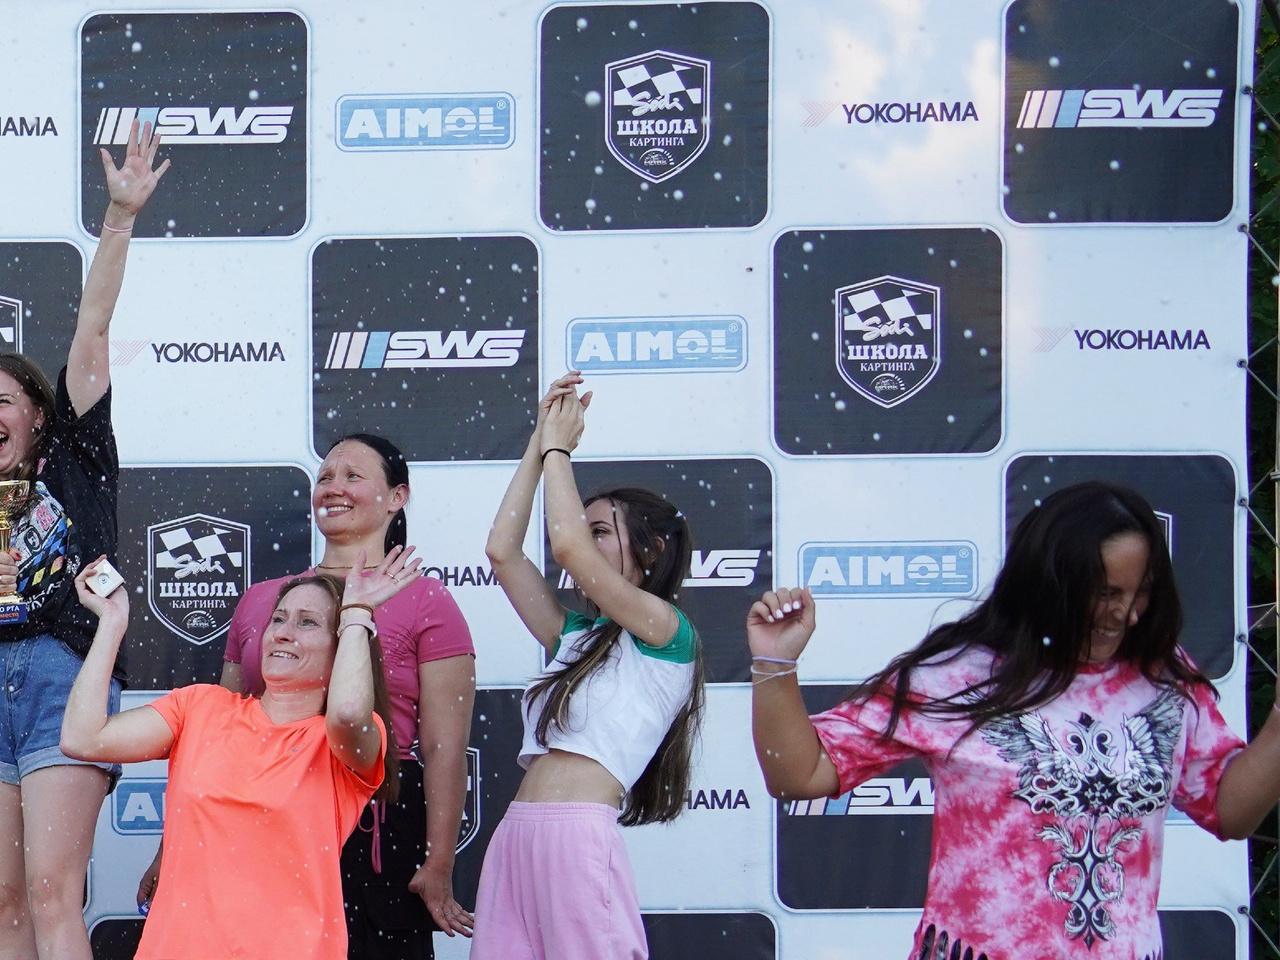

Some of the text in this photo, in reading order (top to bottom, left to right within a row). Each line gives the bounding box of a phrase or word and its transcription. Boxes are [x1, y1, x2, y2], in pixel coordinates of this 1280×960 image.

[842, 101, 979, 124] YOKOHAMA
[1076, 89, 1223, 128] SWS
[151, 106, 294, 144] SWS
[345, 107, 505, 139] AIMOL
[617, 119, 697, 135] ШКОЛА
[629, 137, 685, 147] КАРТИНГА
[384, 329, 526, 368] SWS
[575, 330, 736, 362] AIMOL
[1074, 329, 1211, 350] YOKOHAMA
[151, 341, 286, 363] YOKOHAMA
[847, 344, 928, 360] ШКОЛА
[860, 363, 915, 371] КАРТИНГА
[807, 555, 967, 586] AIMOL
[160, 582, 239, 597] ШКОЛА
[172, 600, 227, 608] КАРТИНГА
[847, 777, 935, 815] SW
